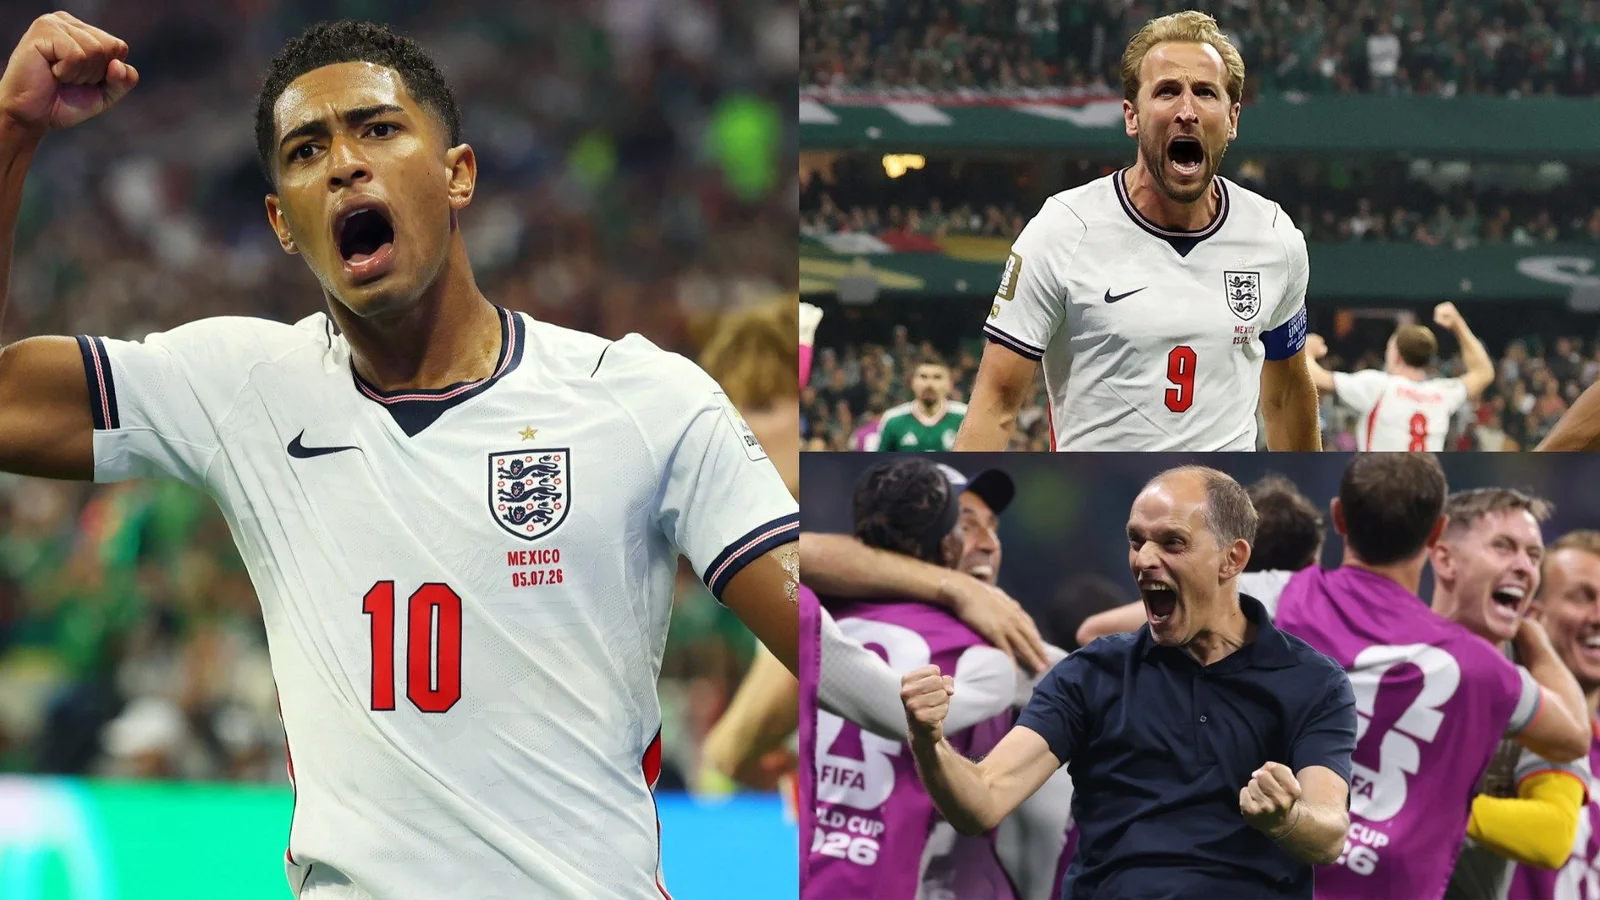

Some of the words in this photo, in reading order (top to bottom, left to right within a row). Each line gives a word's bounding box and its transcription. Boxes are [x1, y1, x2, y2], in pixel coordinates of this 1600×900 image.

[1164, 345, 1197, 413] 9
[507, 549, 560, 566] MEXICO
[512, 569, 563, 588] 05.07.26
[362, 580, 462, 713] 10
[820, 765, 866, 791] FIFA
[847, 815, 885, 838] CUP
[1349, 822, 1389, 849] CUP
